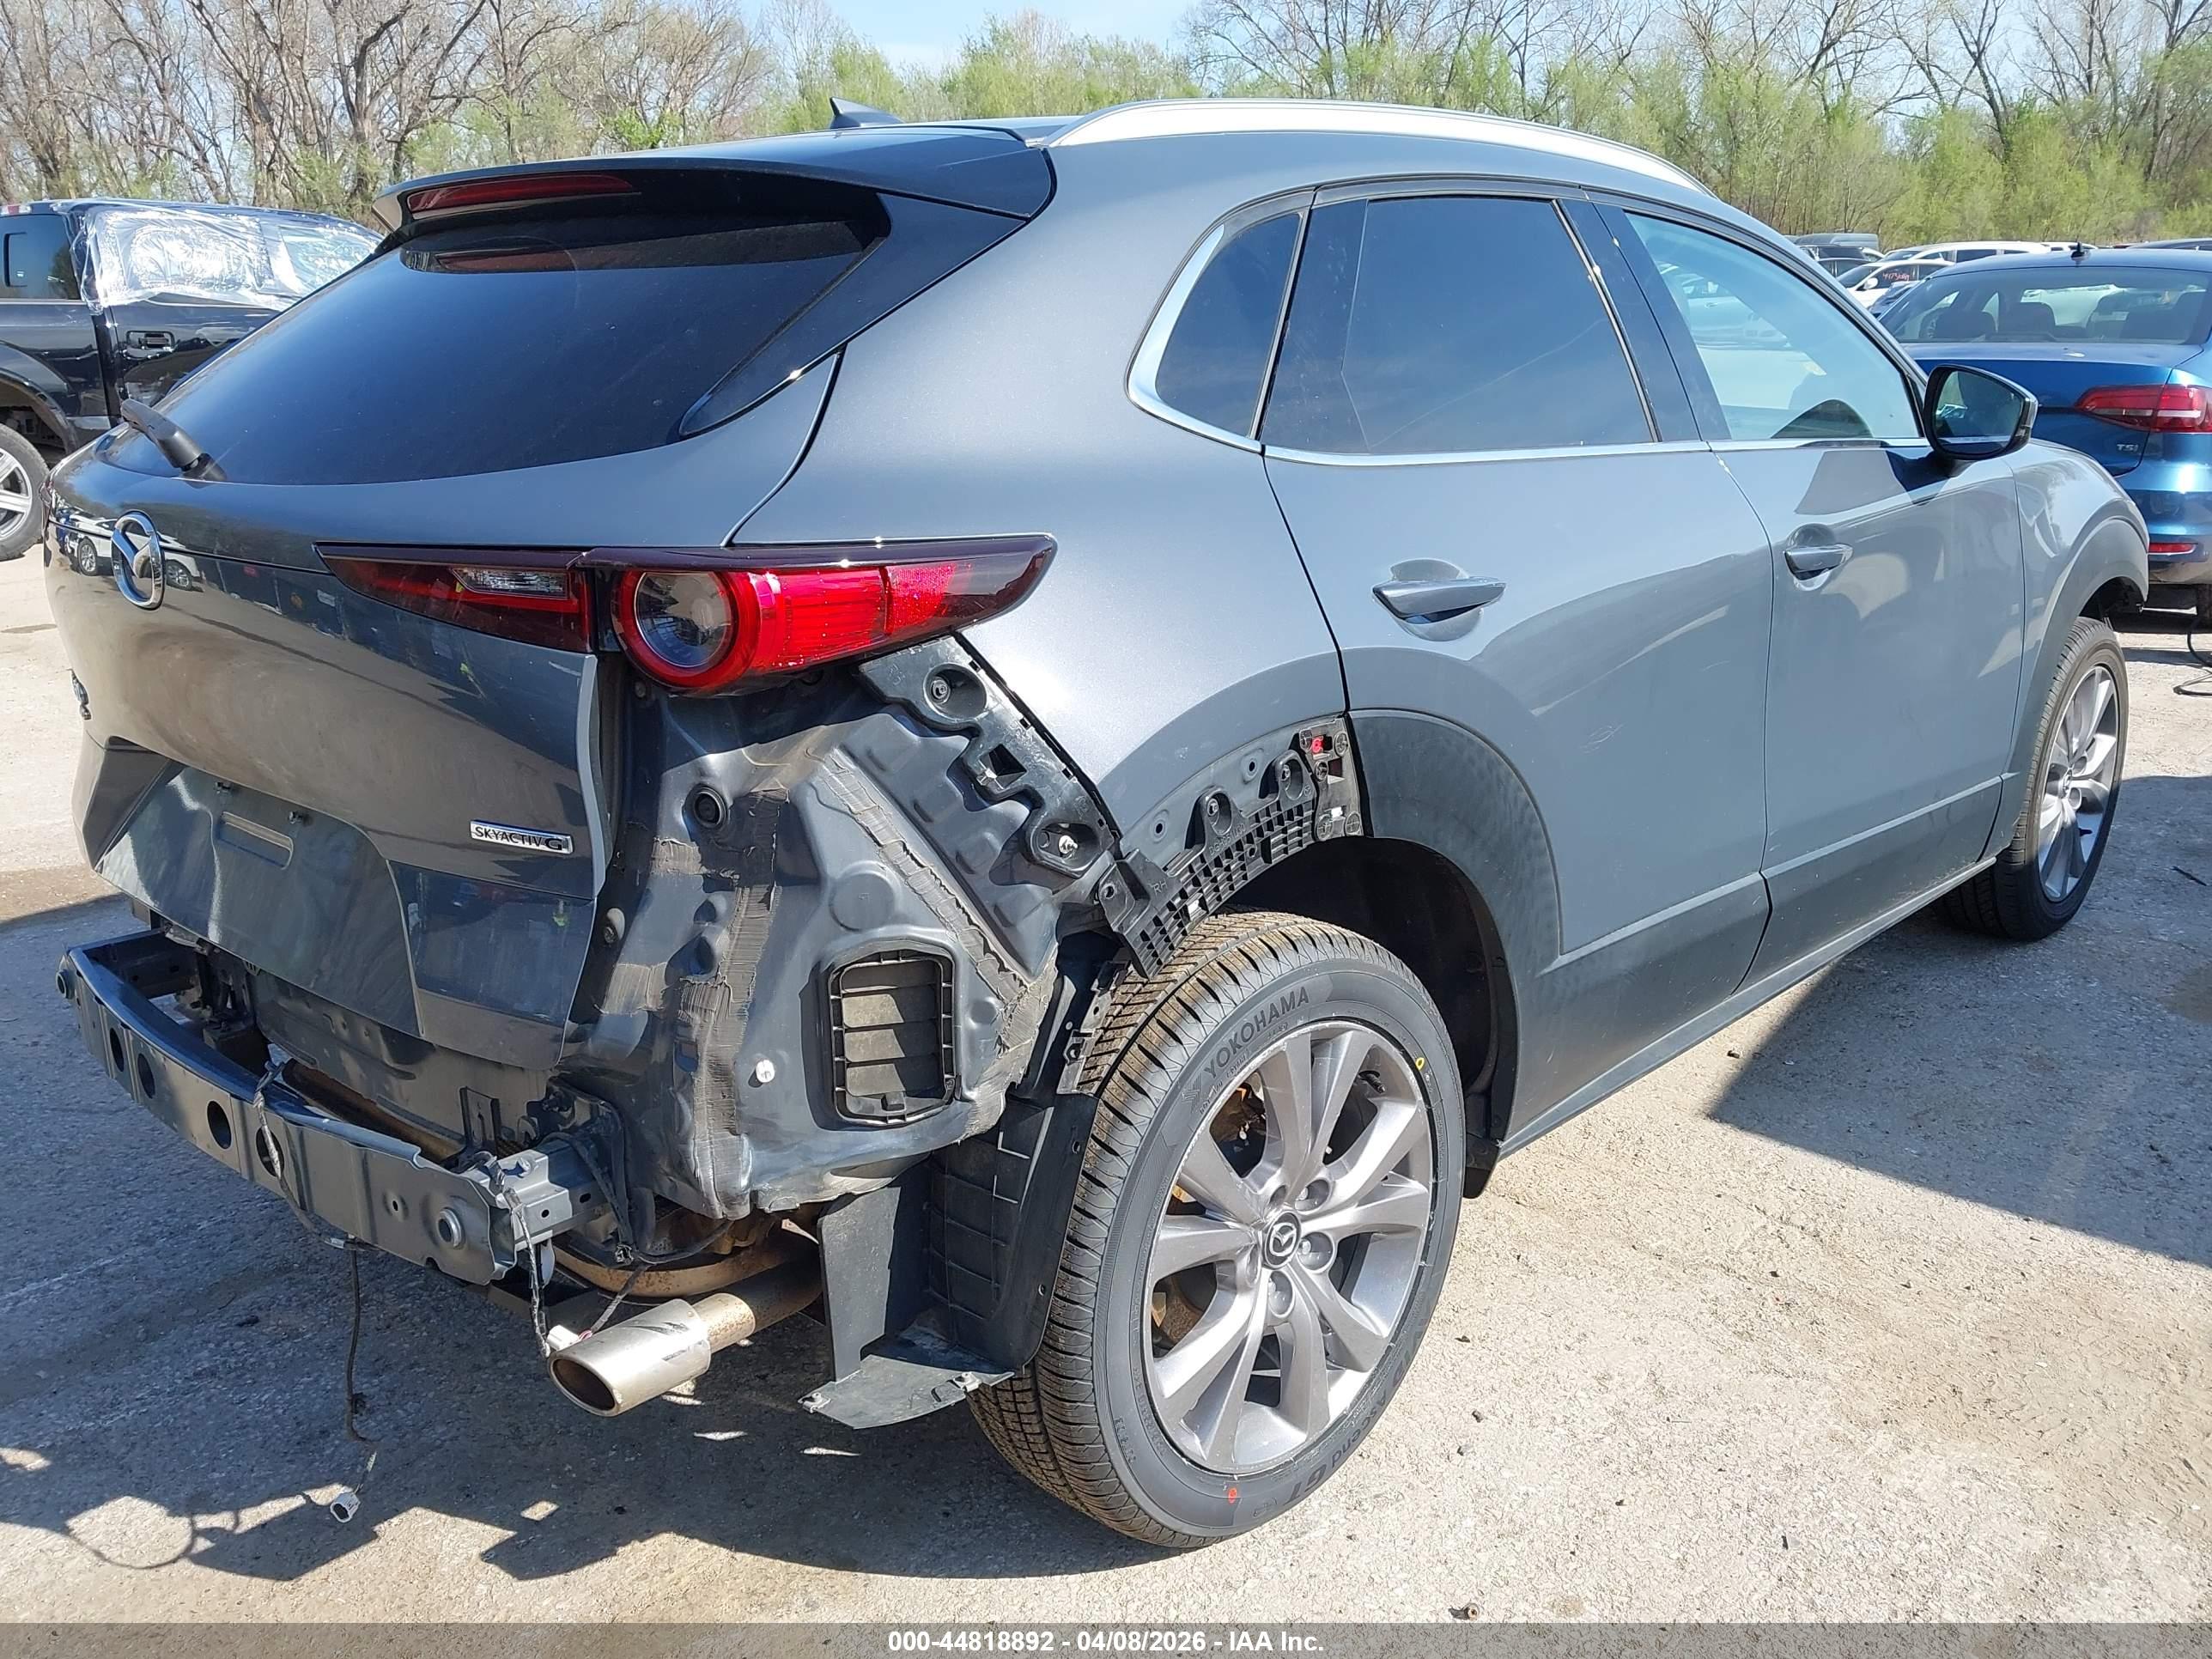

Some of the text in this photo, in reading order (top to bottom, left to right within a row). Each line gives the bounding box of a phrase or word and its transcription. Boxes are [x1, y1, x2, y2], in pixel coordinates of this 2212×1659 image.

[475, 826, 542, 848] SKYACTIV
[1204, 987, 1310, 1079] YOKOHAMA
[1284, 1464, 1327, 1505] GT
